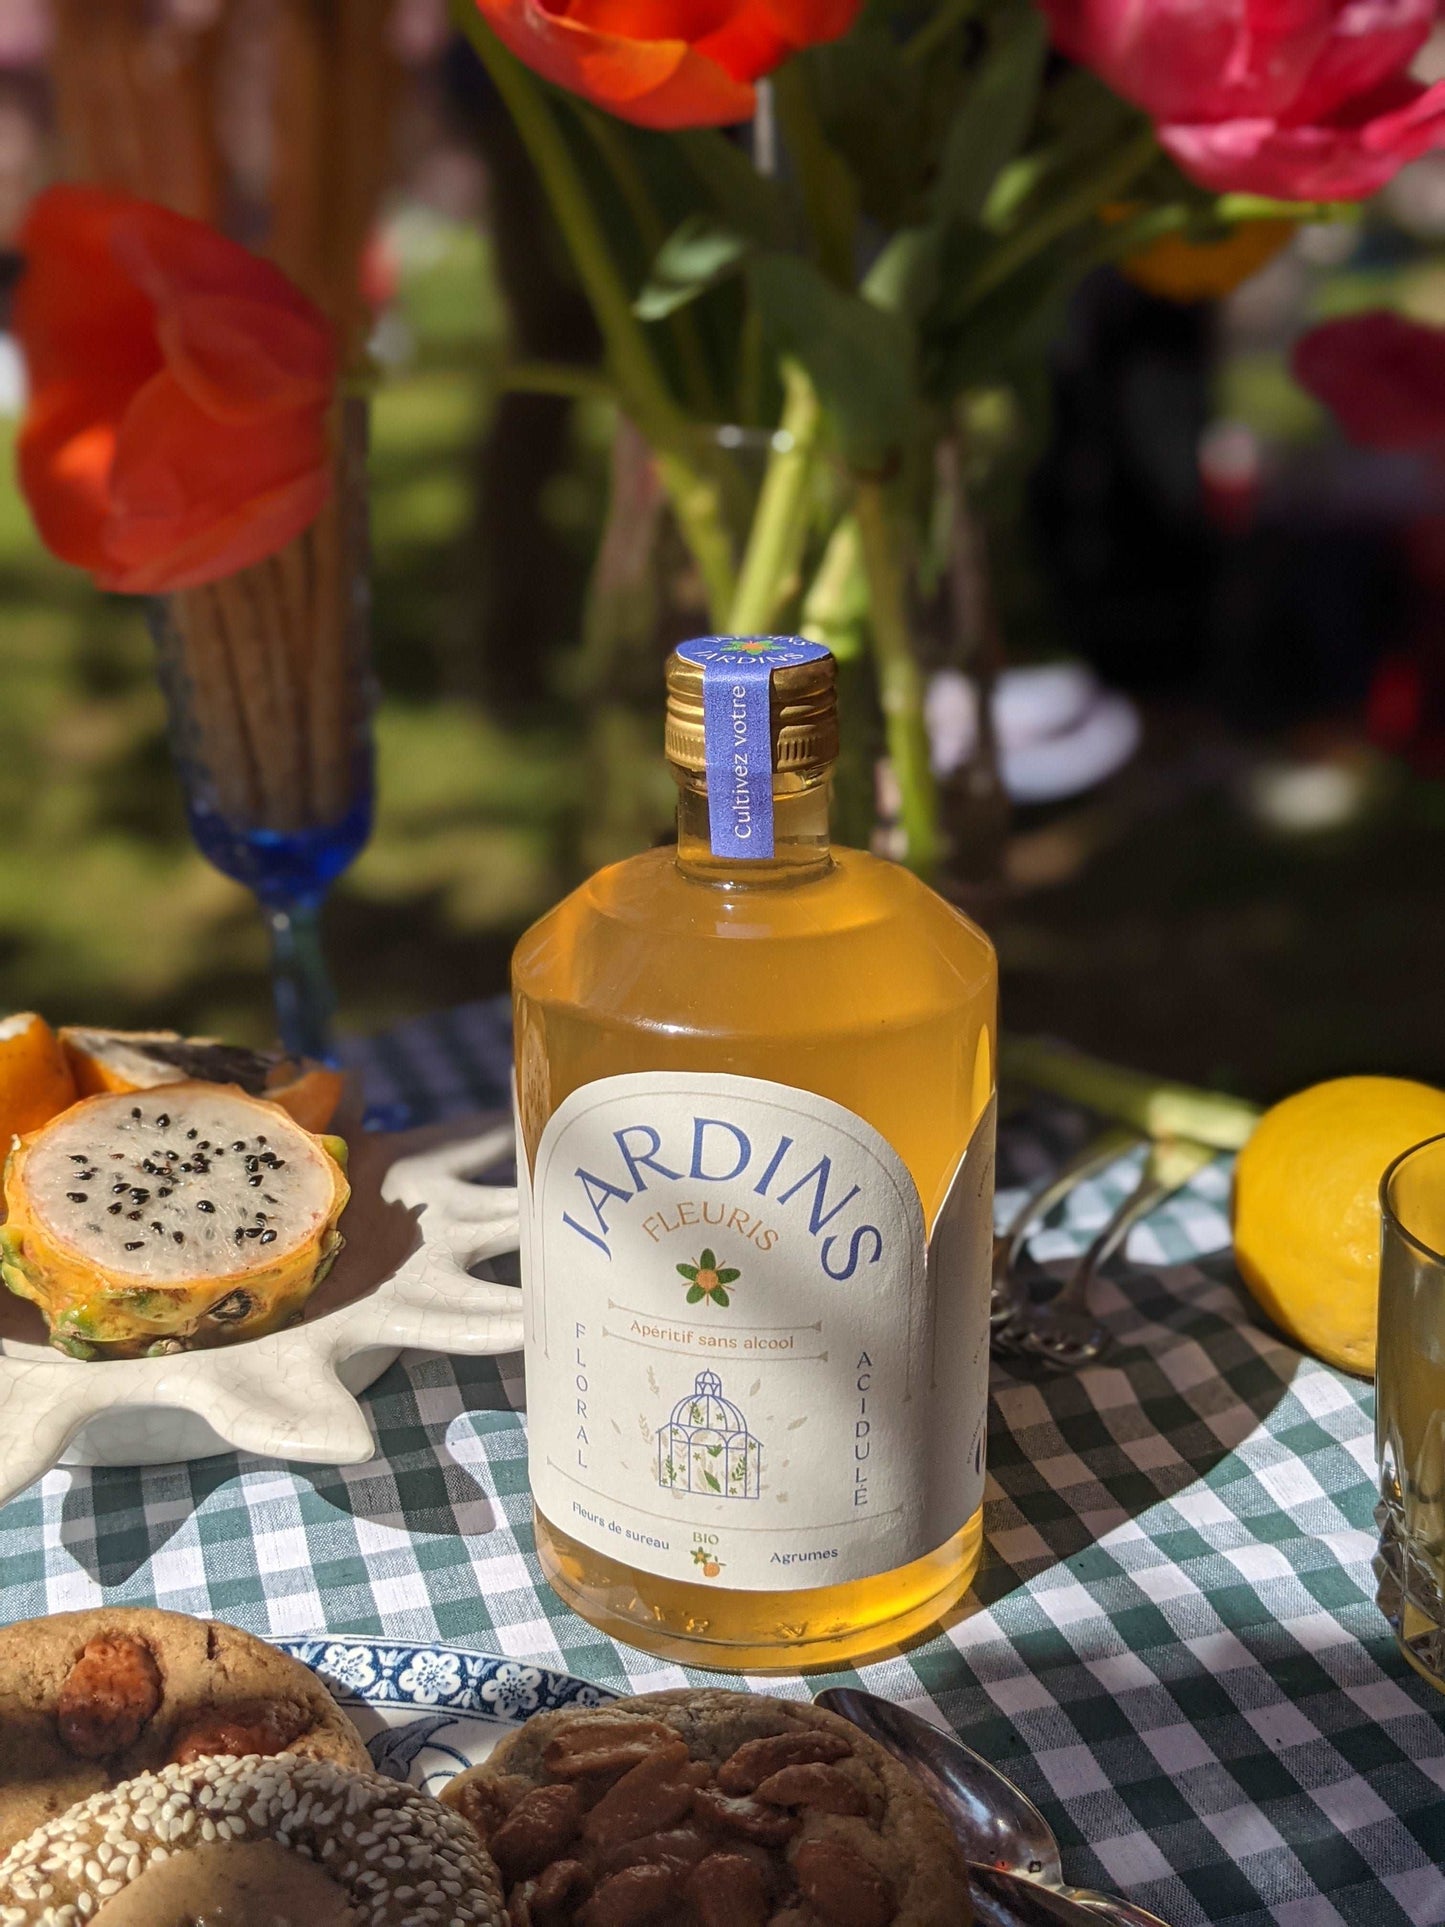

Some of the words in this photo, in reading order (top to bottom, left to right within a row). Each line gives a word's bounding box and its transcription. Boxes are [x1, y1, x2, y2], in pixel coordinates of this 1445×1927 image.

[692, 650, 805, 665] JARDINS
[730, 684, 747, 748] votre
[732, 752, 752, 840] Cultivez
[562, 1116, 883, 1281] JARDINS
[642, 1201, 780, 1251] FLEURIS
[630, 1319, 694, 1344] Apéritif
[698, 1334, 737, 1349] sans
[743, 1335, 794, 1350] alcool
[575, 1322, 589, 1470] FLORAL
[854, 1351, 873, 1507] ACIDULÉ
[572, 1500, 605, 1528] Fleurs
[608, 1519, 622, 1535] de
[625, 1528, 670, 1551] sureau
[692, 1531, 720, 1546] BIO
[770, 1547, 839, 1565] Agrumes
